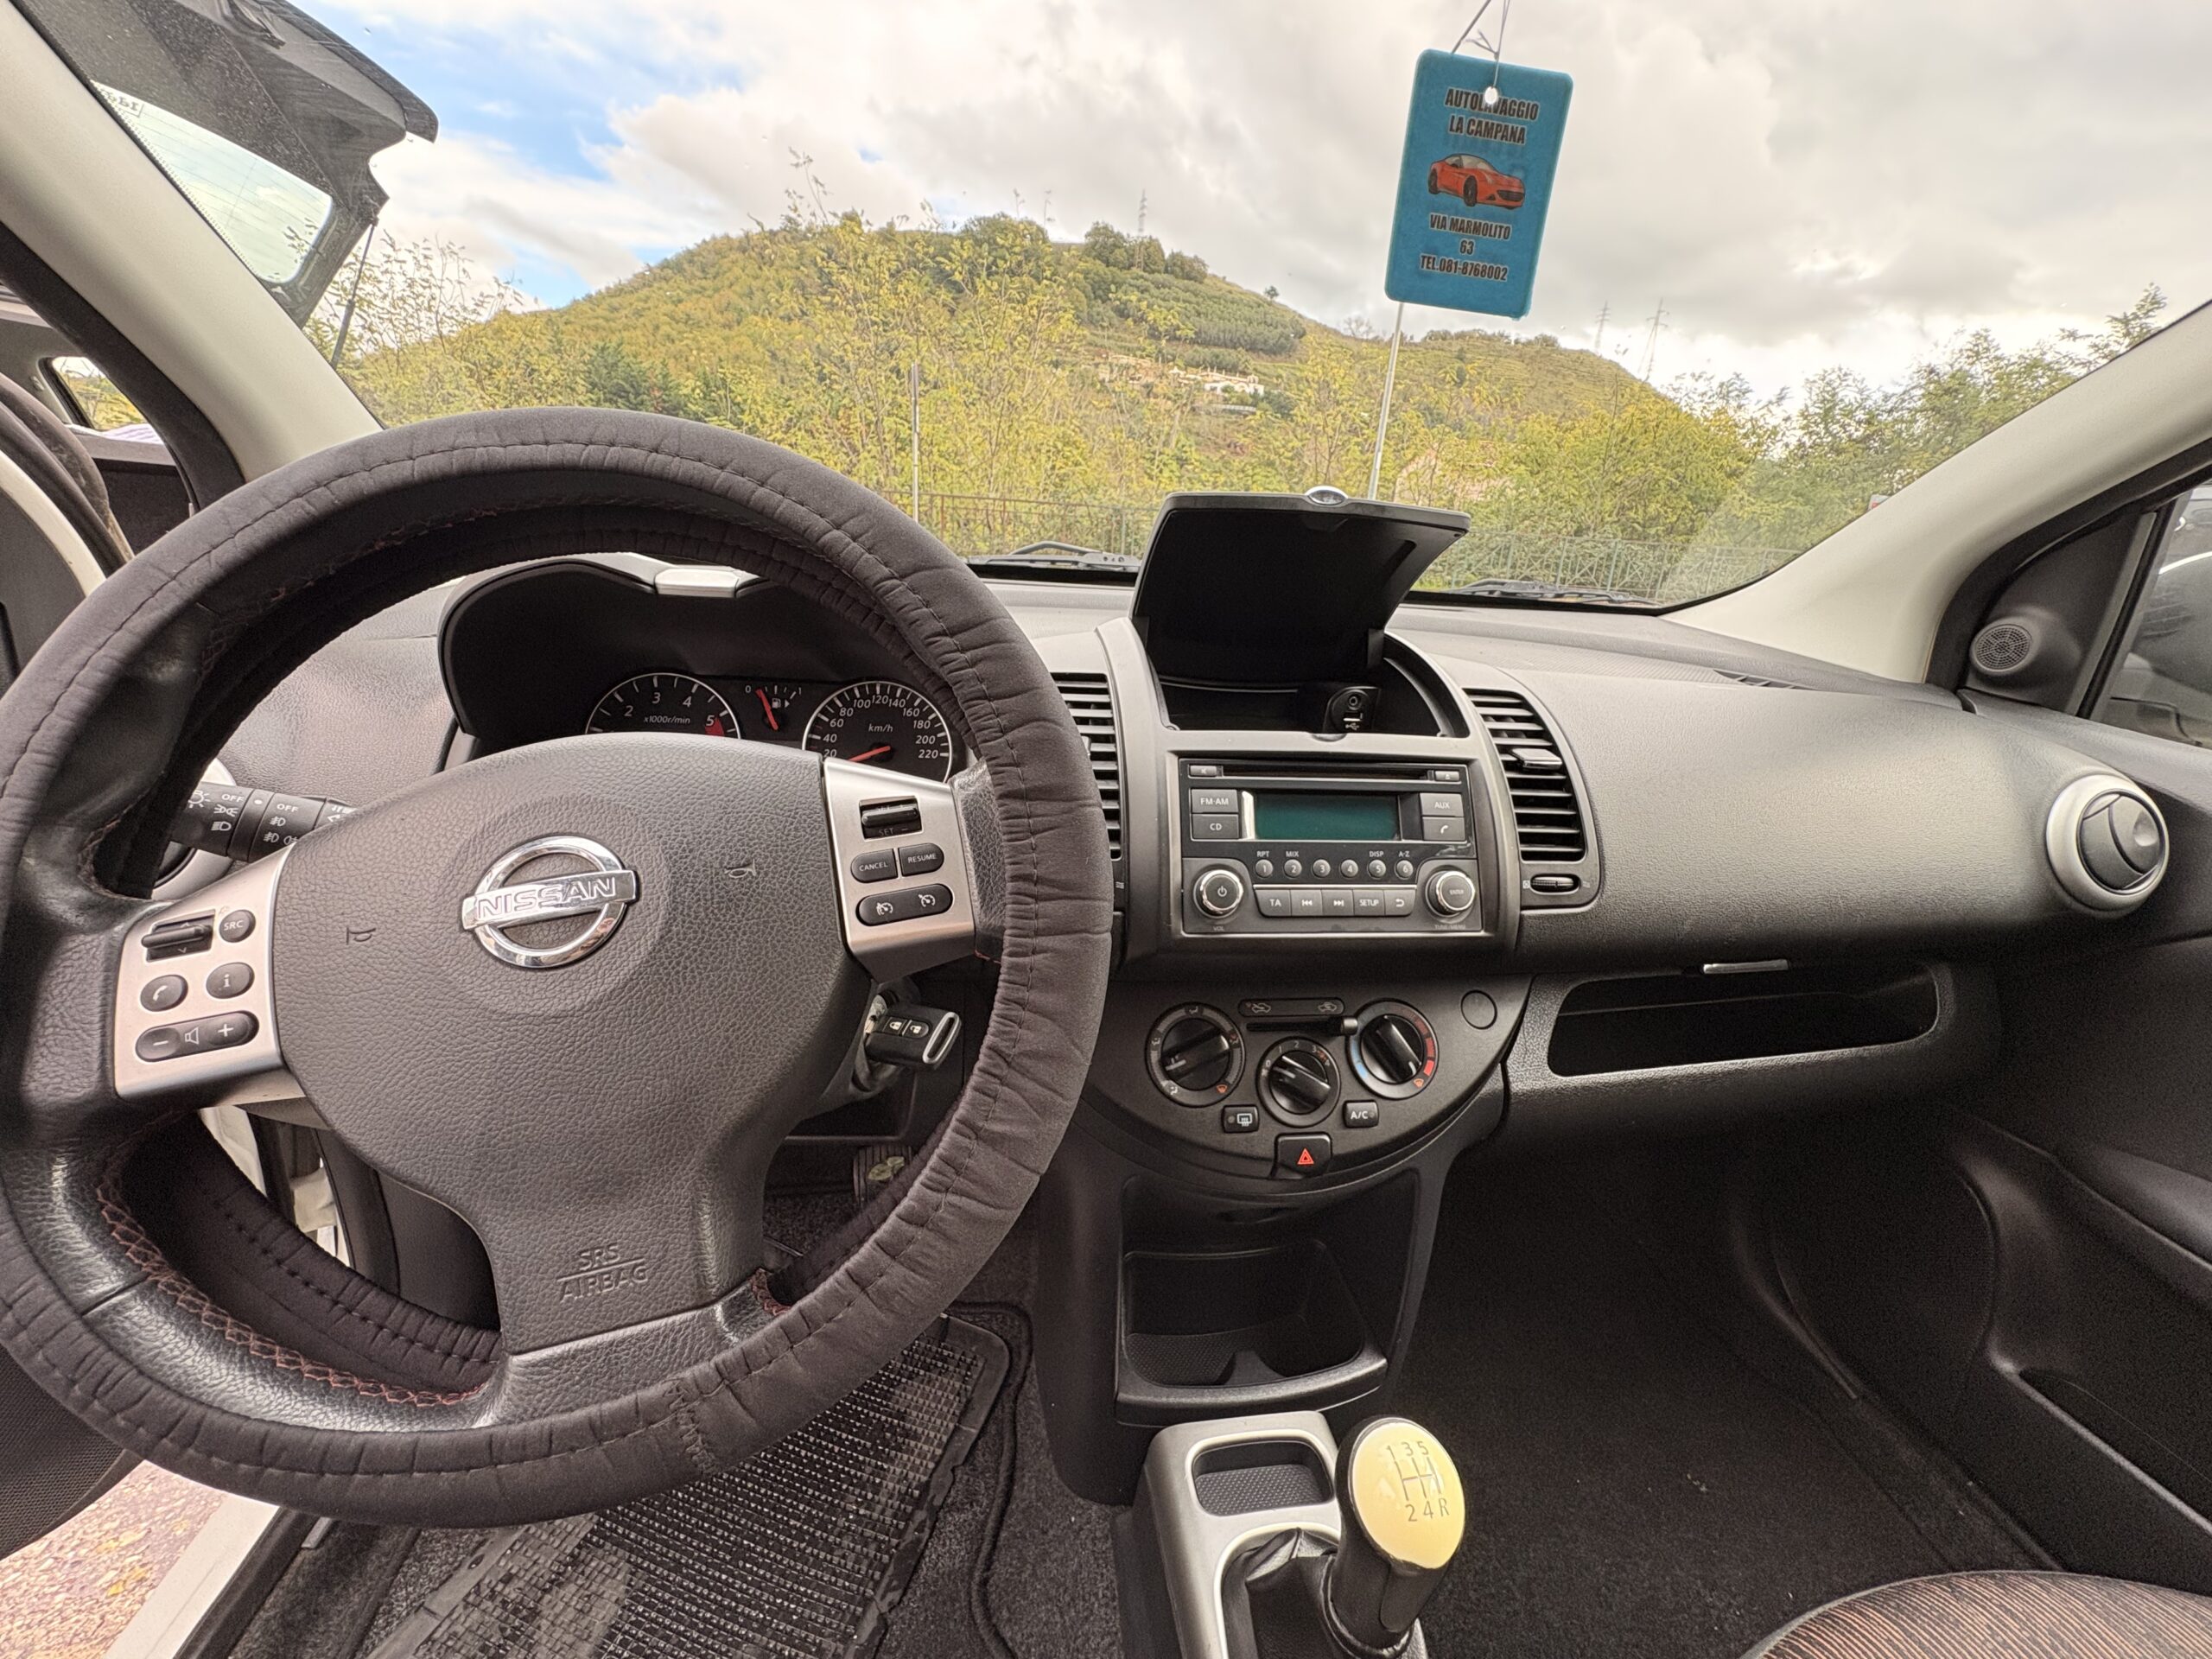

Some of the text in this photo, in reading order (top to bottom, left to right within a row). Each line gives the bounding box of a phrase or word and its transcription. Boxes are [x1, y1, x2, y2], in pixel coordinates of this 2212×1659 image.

[1449, 115, 1527, 144] LA CAMPANA
[1430, 213, 1511, 240] VIA MARMOLITO
[1459, 239, 1475, 255] 63
[1420, 255, 1509, 281] TEL.081-8768002
[652, 691, 661, 704] 3
[682, 696, 692, 708] 4
[872, 695, 889, 705] 120
[853, 699, 871, 709] 100
[888, 698, 906, 709] 140
[624, 705, 634, 717] 2
[839, 707, 854, 717] 80
[903, 708, 920, 717] 160
[643, 715, 690, 726] x1000r/min
[705, 715, 715, 727] 5
[830, 718, 844, 728] 60
[913, 720, 931, 729] 180
[868, 723, 893, 733] km/h
[823, 734, 837, 743] 40
[915, 735, 936, 745] 200
[823, 749, 837, 759] 20
[918, 749, 938, 759] 220
[221, 792, 244, 803] OFF
[276, 803, 299, 814] OFF
[1434, 801, 1450, 810] AUX
[878, 827, 894, 836] SET
[1210, 823, 1223, 831] CD
[907, 852, 938, 864] RESUME
[859, 861, 888, 873] CANCEL
[1291, 865, 1297, 874] 2
[475, 876, 616, 922] NISSAN
[1269, 899, 1281, 907] TA
[1359, 899, 1380, 907] SETUP
[223, 919, 245, 931] SRC
[1351, 1109, 1370, 1122] A/C
[578, 1244, 620, 1271] SRS
[559, 1265, 649, 1304] AIRBAG
[1385, 1440, 1430, 1460] 1 3 5
[1404, 1497, 1450, 1522] 2 4 R
